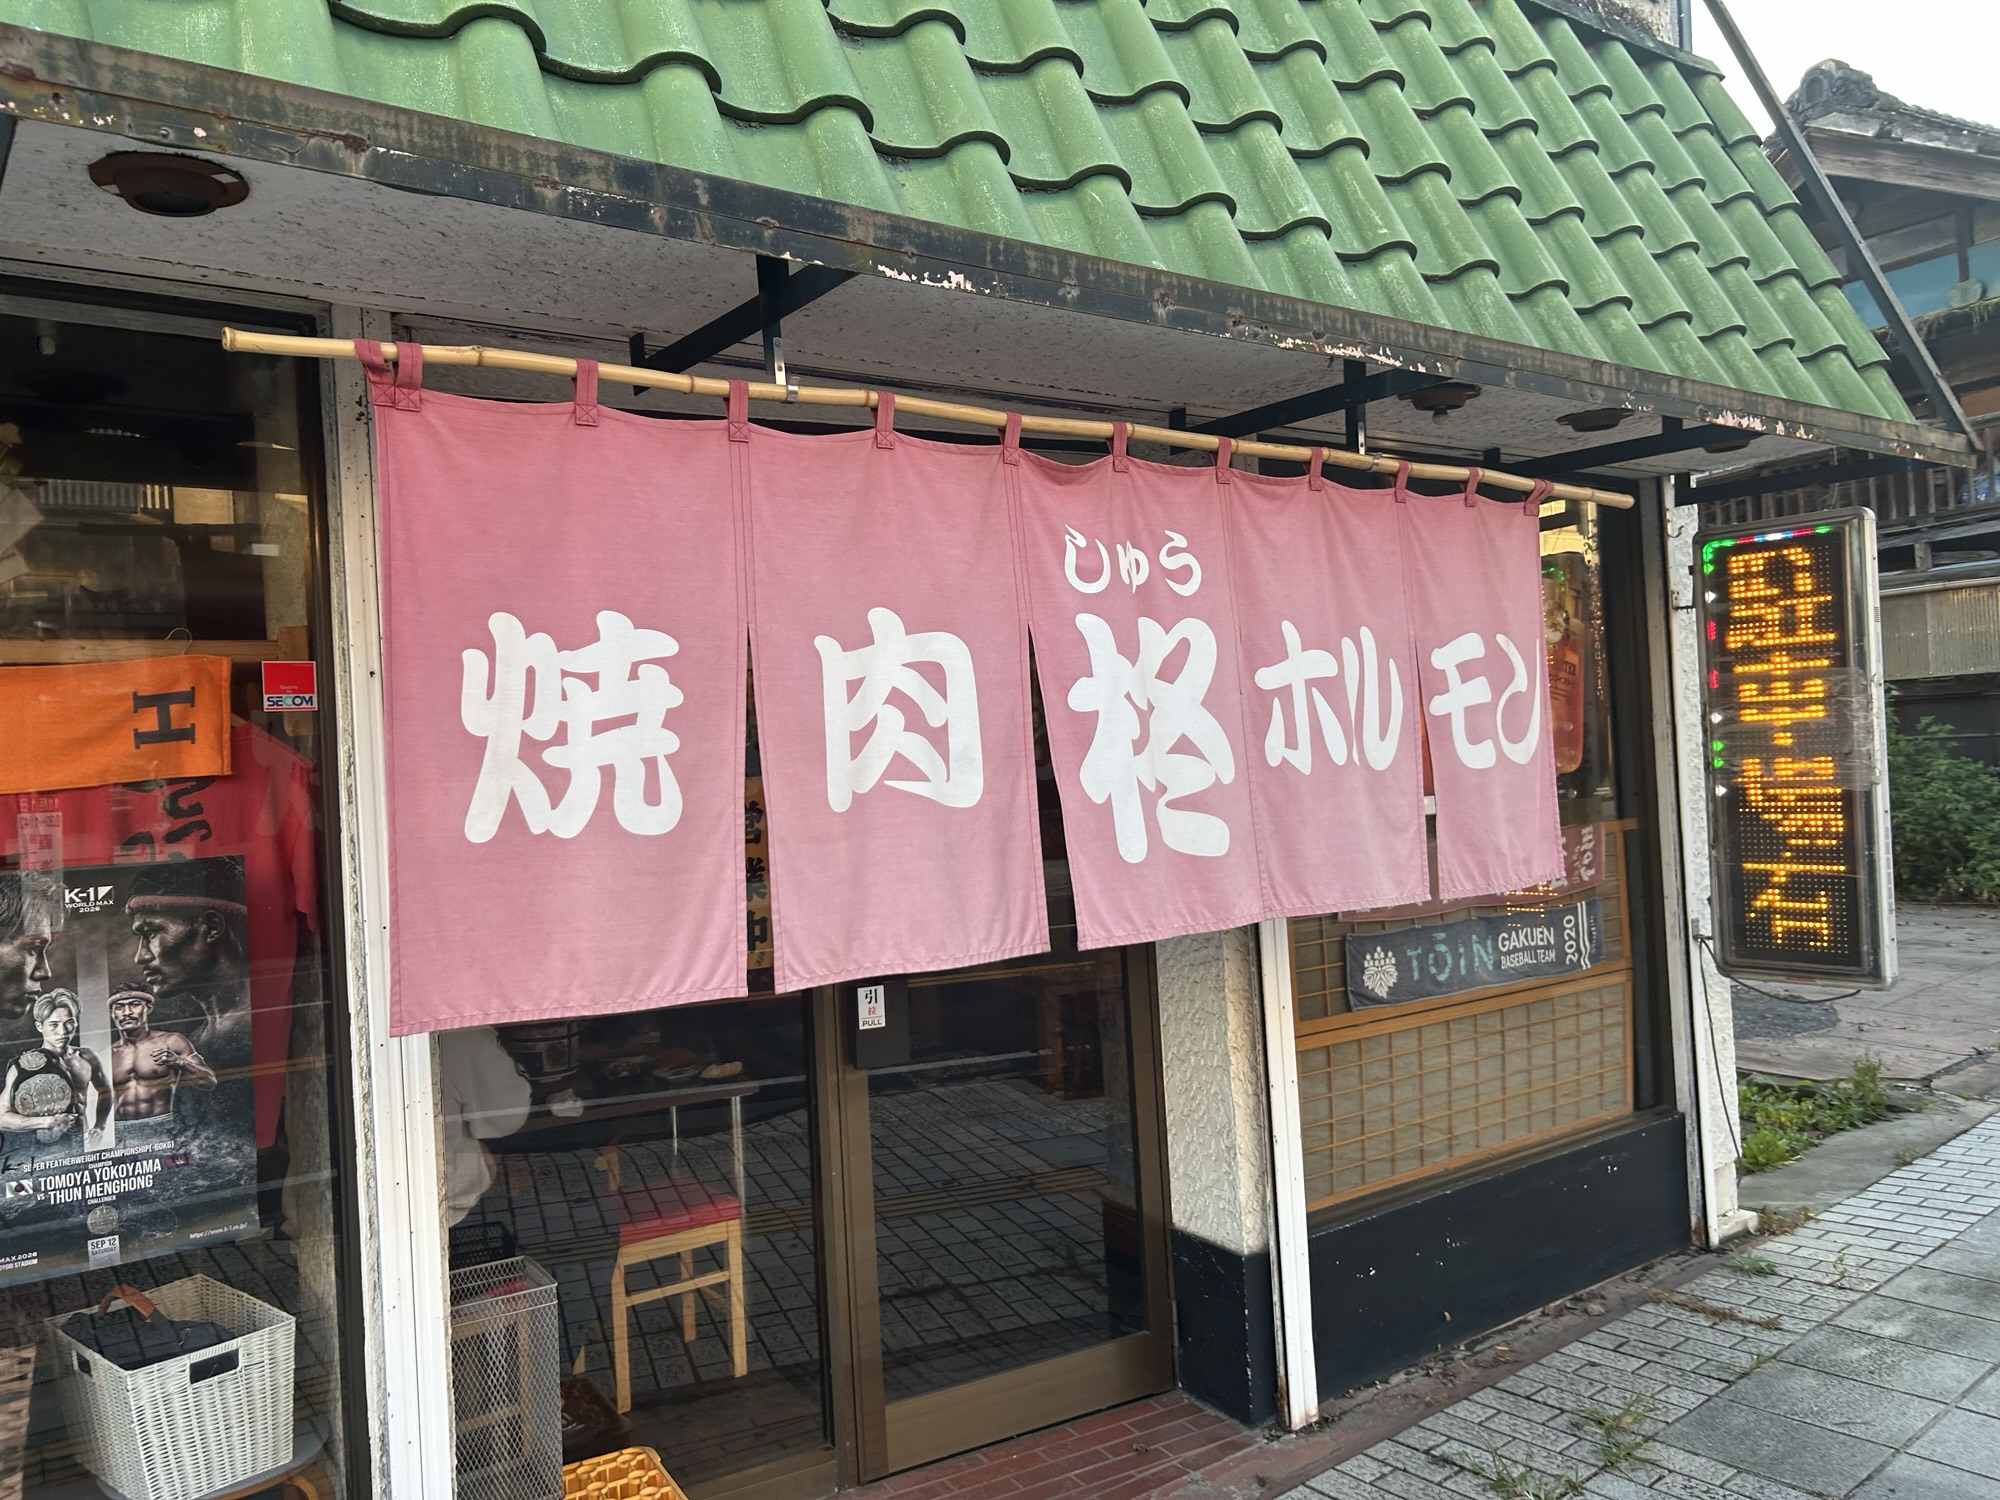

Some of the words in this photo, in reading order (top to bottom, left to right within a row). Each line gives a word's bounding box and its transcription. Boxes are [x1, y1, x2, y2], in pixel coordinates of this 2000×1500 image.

[267, 695, 313, 707] SECOM
[64, 887, 95, 903] K-1
[65, 901, 95, 909] WORLD
[1498, 926, 1555, 952] GAKUEN
[1563, 915, 1579, 965] 2020
[1501, 953, 1537, 970] BASEBALL
[1537, 949, 1556, 965] TEAM
[863, 988, 878, 1004] 引
[862, 1019, 882, 1027] PULL
[23, 1162, 45, 1173] SUPER
[46, 1153, 100, 1169] FEATHERWEIGHT
[39, 1169, 91, 1192] TOMOYA
[92, 1158, 161, 1181] YOKOYAMA
[49, 1187, 82, 1205] THUN
[86, 1175, 153, 1198] MENGHONG
[91, 1240, 106, 1250] SEP
[108, 1238, 117, 1246] 12
[91, 1247, 117, 1256] SATURDAY
